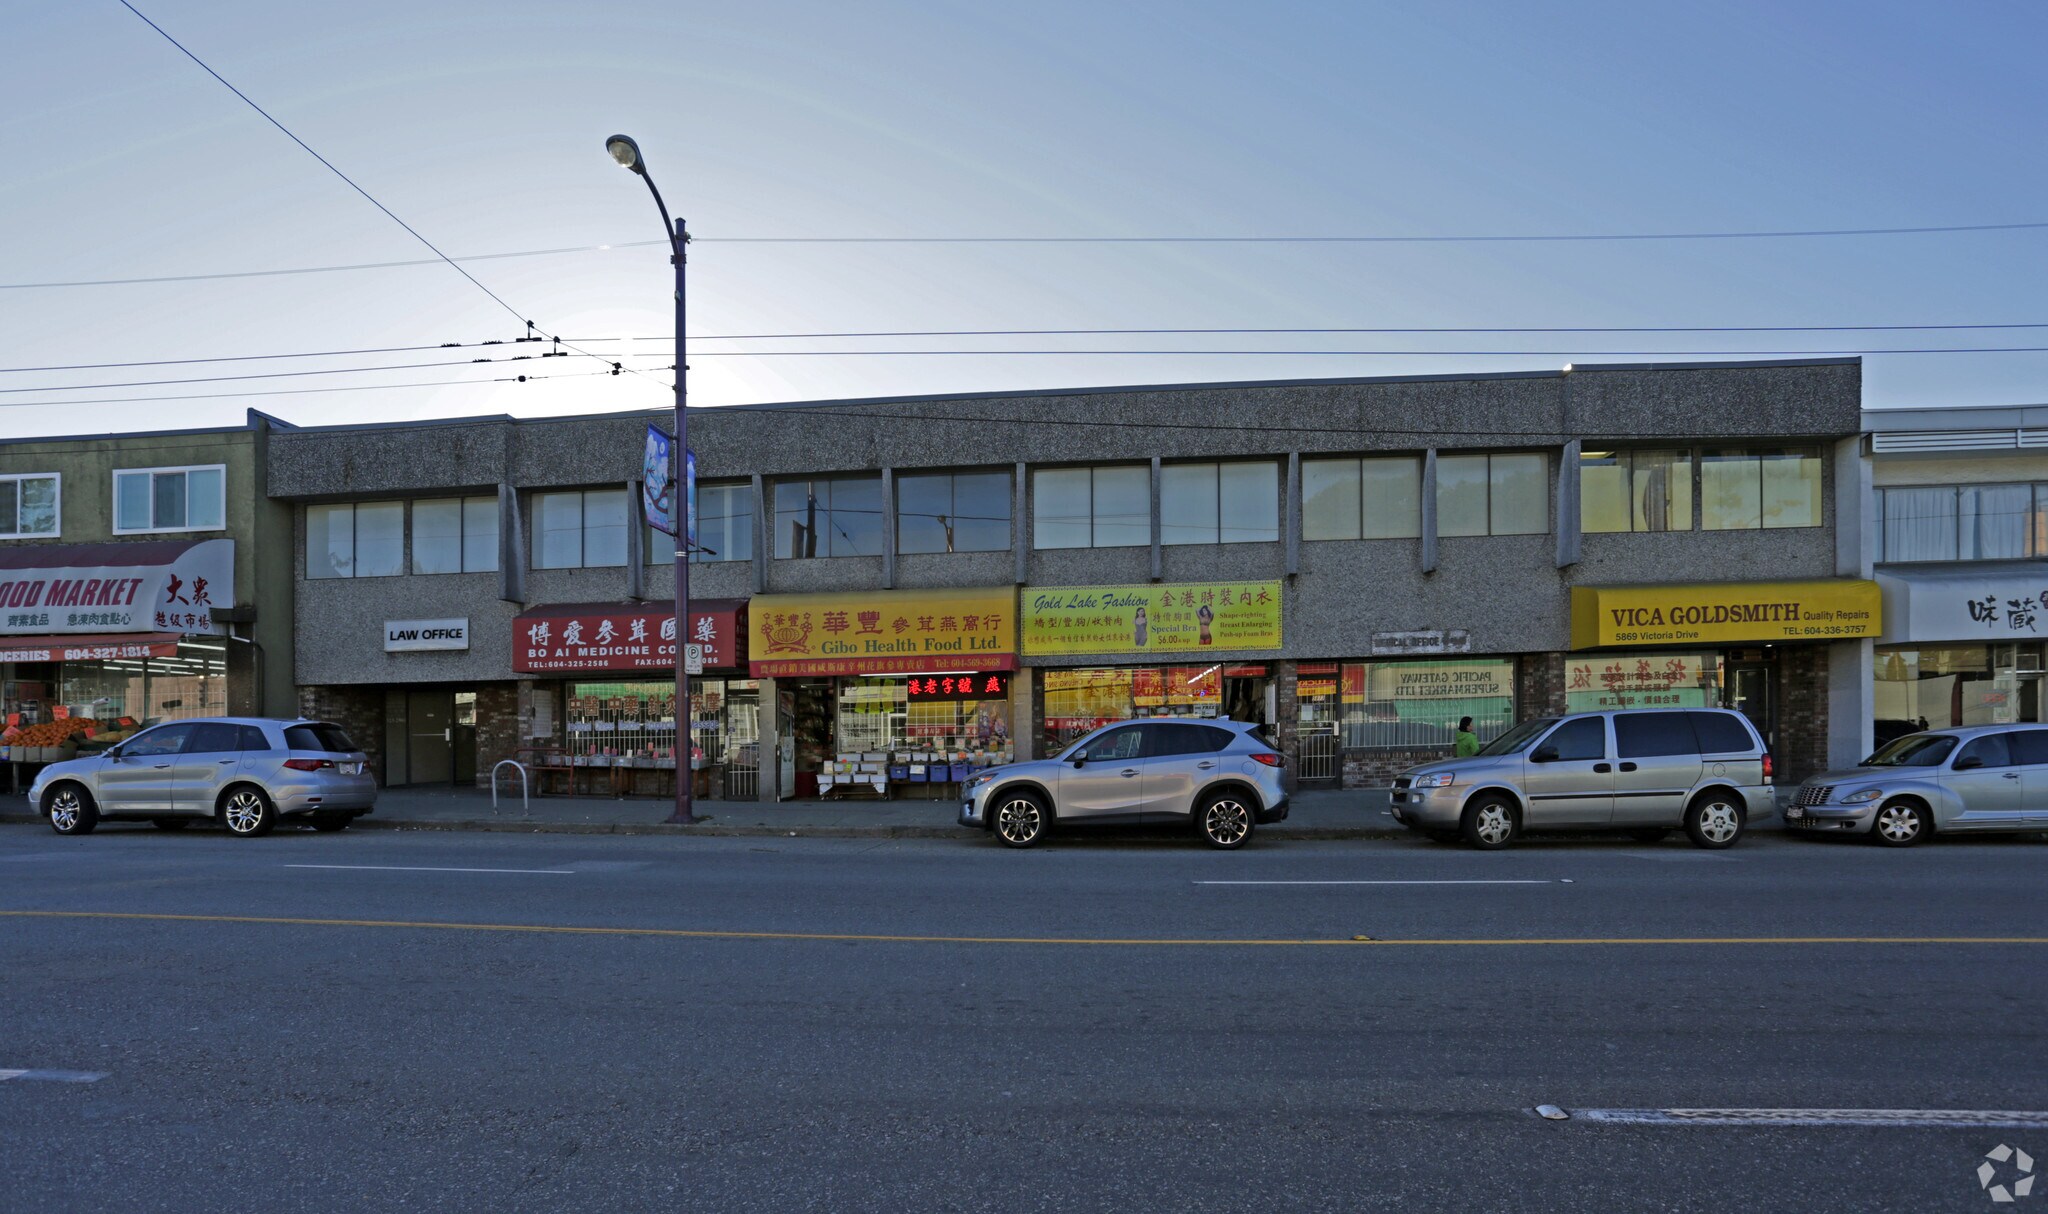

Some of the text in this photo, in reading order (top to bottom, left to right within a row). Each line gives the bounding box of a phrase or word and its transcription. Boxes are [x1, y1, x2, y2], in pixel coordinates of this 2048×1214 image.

[44, 578, 144, 606] MARKET
[1034, 593, 1149, 614] Gold Lake Fashion
[1611, 603, 1800, 627] VICA GOLDSMITH
[1803, 609, 1870, 623] Quality Repairs
[1151, 624, 1197, 634] Special Bra
[1241, 621, 1272, 629] Enlarging
[1783, 625, 1867, 635] TEL: 604-336-3757
[389, 628, 463, 641] LAW OFFICE
[1158, 635, 1178, 644] $6.00
[1615, 630, 1699, 641] 5869 Victoria Drive
[528, 648, 547, 658] BO
[555, 647, 570, 657] AI
[578, 645, 650, 657] MEDICINE
[821, 636, 1002, 655] Gibo Health Food Ltd.
[0, 645, 151, 663] CERIES 604-327-1814
[568, 694, 600, 717] 中醫
[607, 695, 640, 716] 中藥
[690, 719, 720, 731] assage
